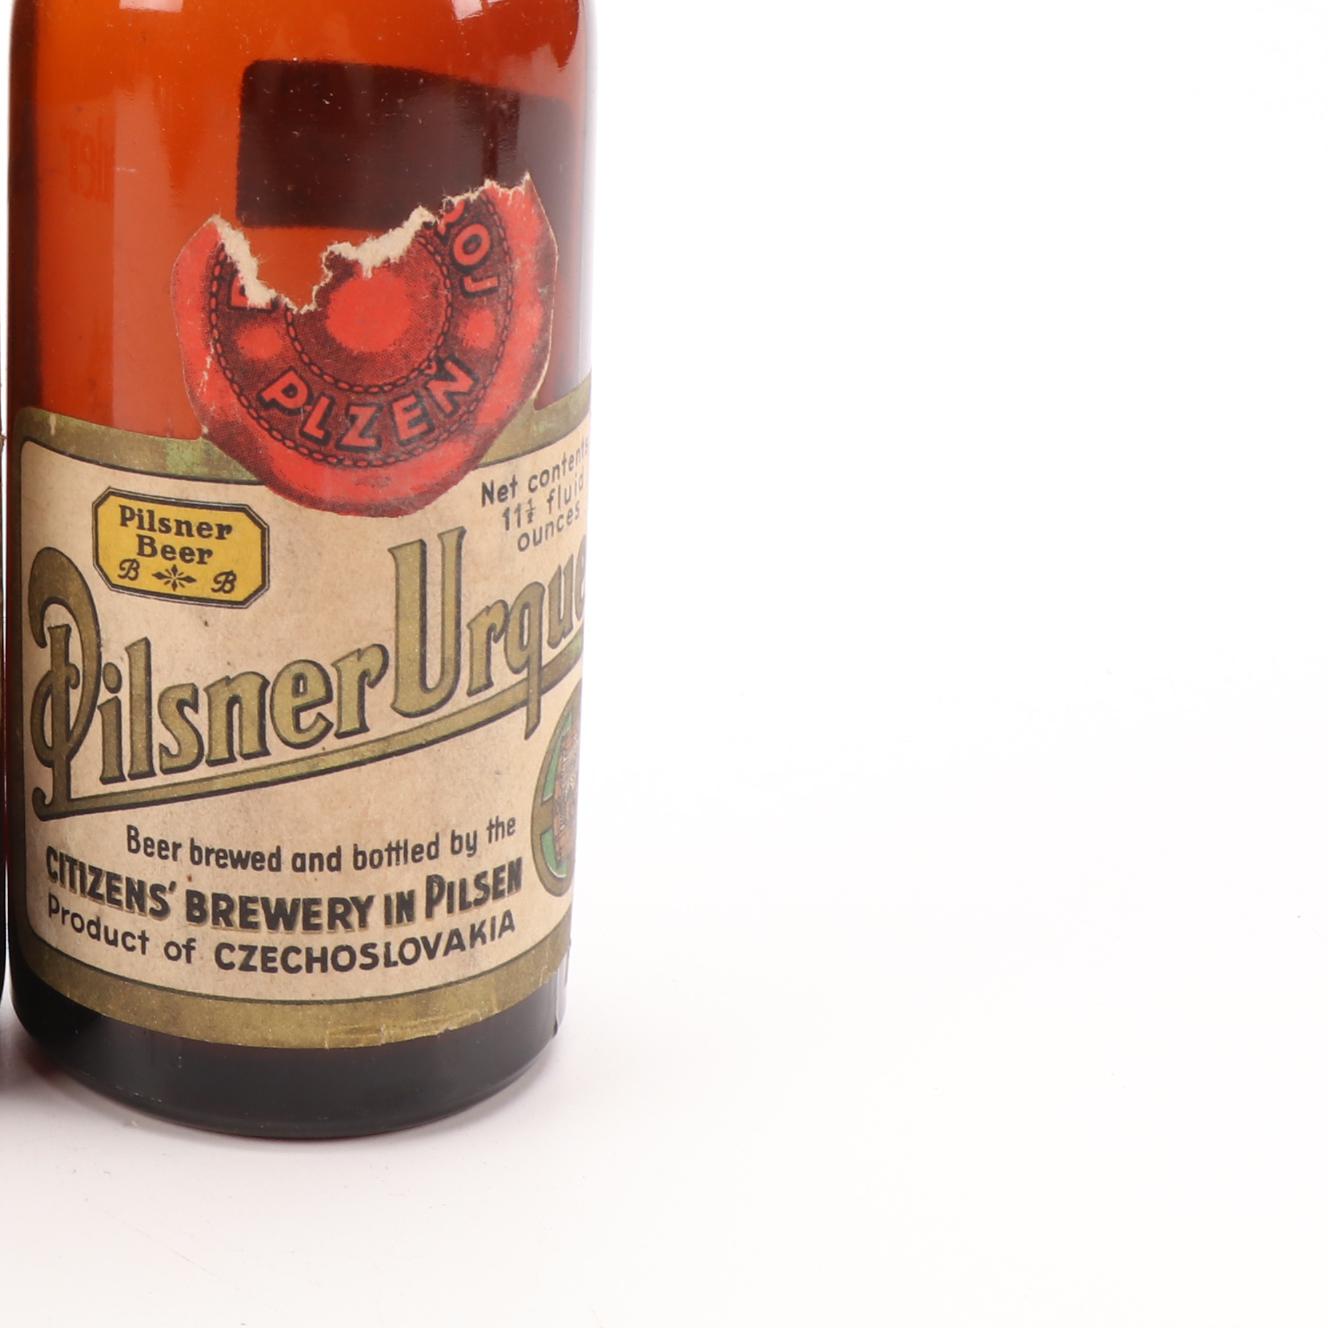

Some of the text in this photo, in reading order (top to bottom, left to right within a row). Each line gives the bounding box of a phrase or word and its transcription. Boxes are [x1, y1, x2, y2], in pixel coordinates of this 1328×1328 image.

[481, 474, 518, 508] Net
[546, 469, 585, 516] fluid
[118, 504, 233, 541] Pilsner
[517, 500, 581, 552] ounces
[136, 534, 213, 566] Beer
[28, 546, 389, 822] Pilsner
[126, 815, 517, 873] Beer brewed and bottled by the
[45, 844, 524, 932] CITIZENS' BREWERY IN PILSEN
[47, 894, 516, 974] Product of CZECHOSLOVAKIA
